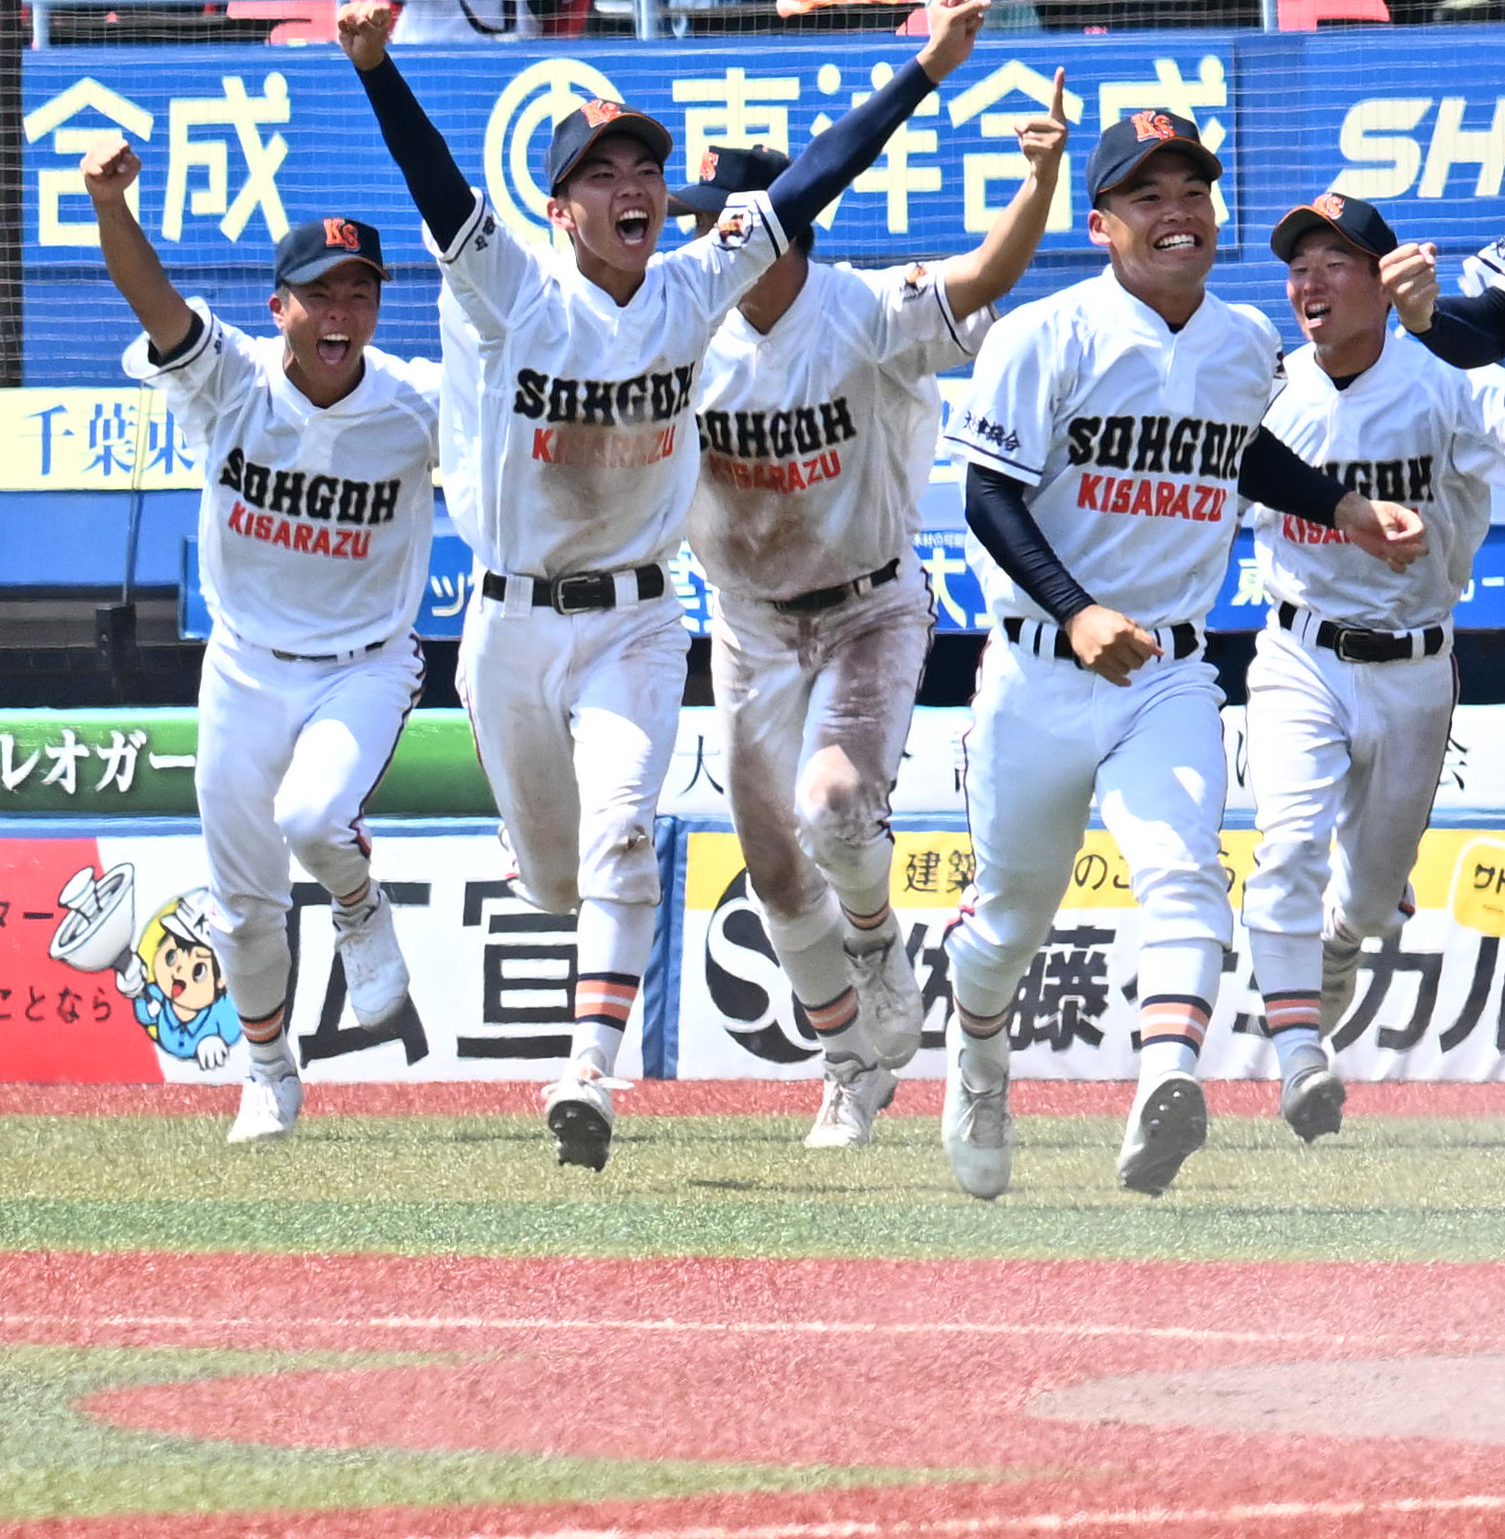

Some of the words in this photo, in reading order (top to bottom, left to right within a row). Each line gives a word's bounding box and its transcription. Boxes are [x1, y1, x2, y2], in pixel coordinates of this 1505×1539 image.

[325, 217, 360, 251] KS
[514, 363, 697, 428] SOHGOH
[1068, 415, 1246, 479] SOHGOH
[219, 448, 400, 525] SOHGOH
[1077, 472, 1228, 523] KISARAZU
[229, 501, 371, 560] KISARAZU
